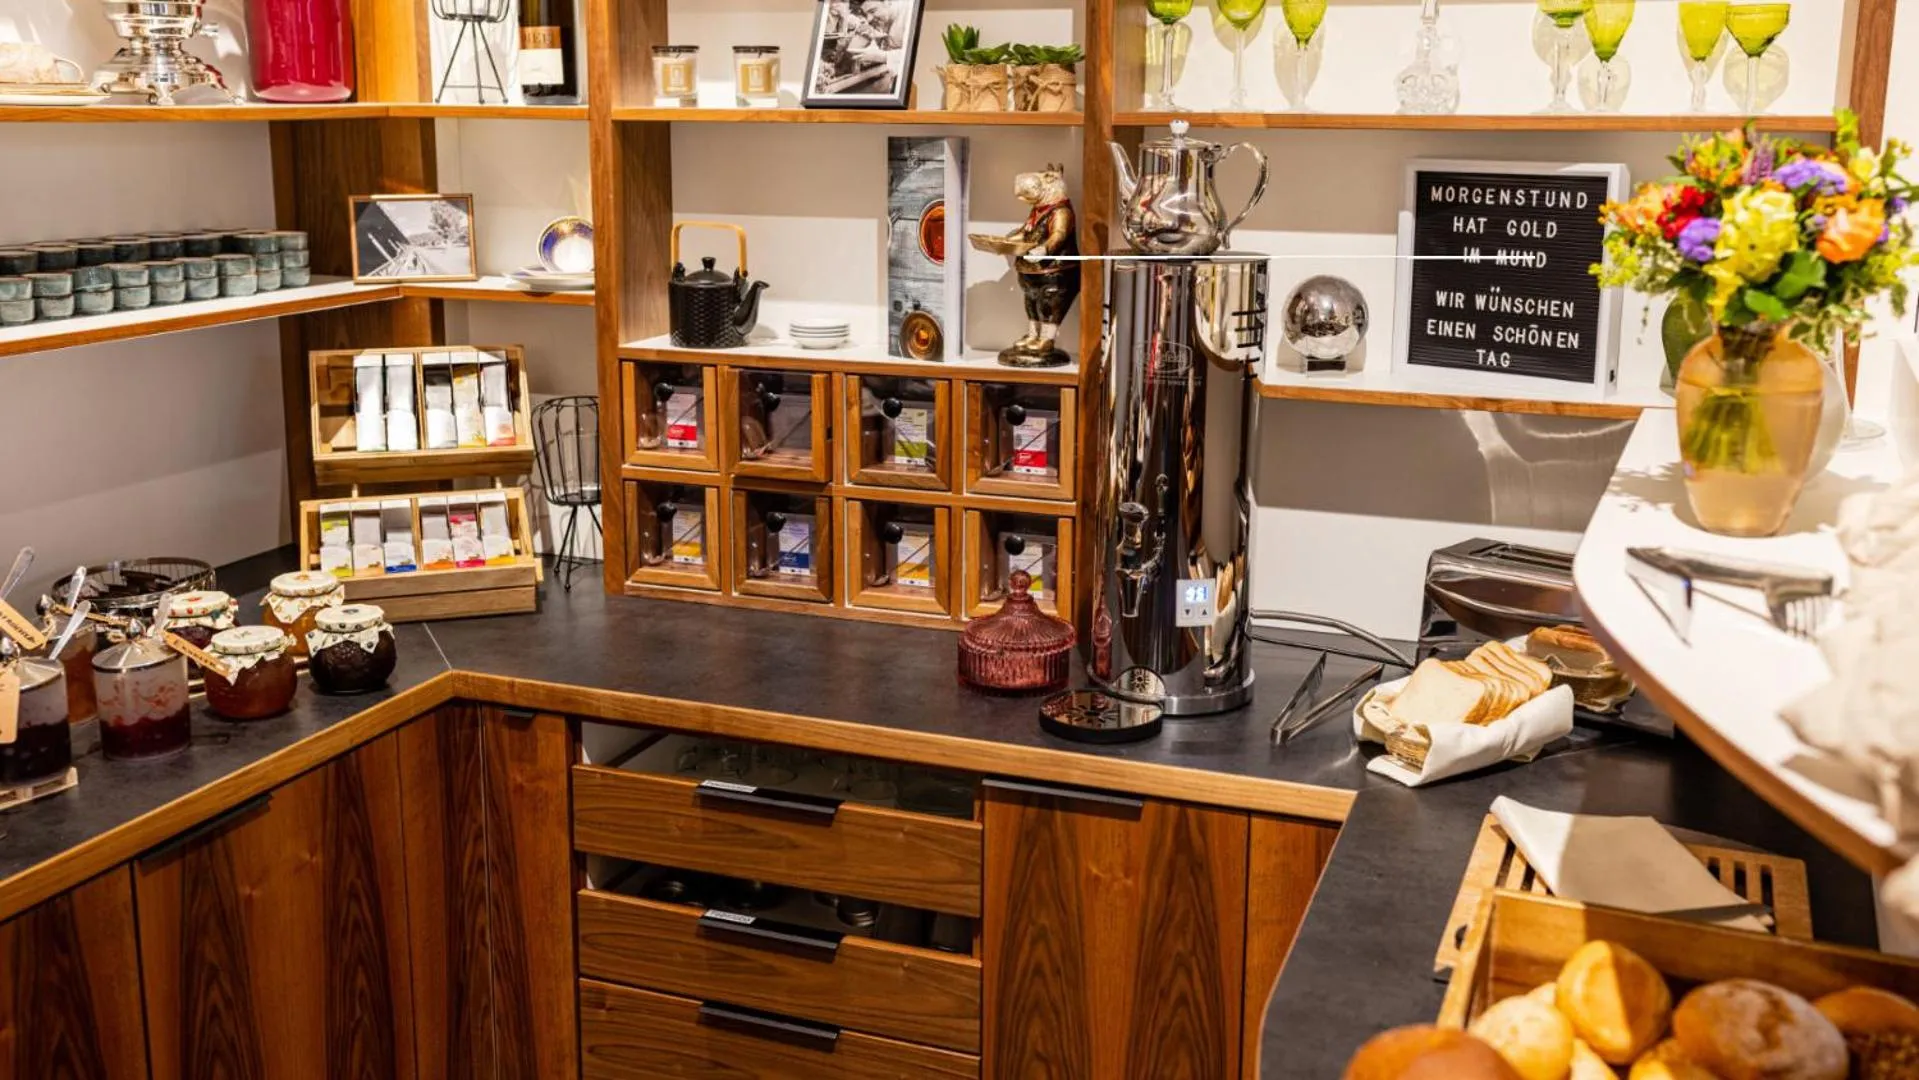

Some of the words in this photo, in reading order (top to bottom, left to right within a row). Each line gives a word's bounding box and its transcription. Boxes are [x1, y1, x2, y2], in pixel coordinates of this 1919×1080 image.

[1430, 185, 1588, 209] MORGENSTUND
[1453, 215, 1488, 234] HAT
[1506, 219, 1558, 238] GOLD
[1463, 246, 1481, 264] IM
[1495, 249, 1547, 268] MUND
[1435, 290, 1465, 309] WIR
[1475, 286, 1575, 319] WÜNSCHEN
[1426, 319, 1476, 339] EINEN
[1493, 324, 1579, 349] SCHÖNEN
[1476, 349, 1511, 367] TAG
